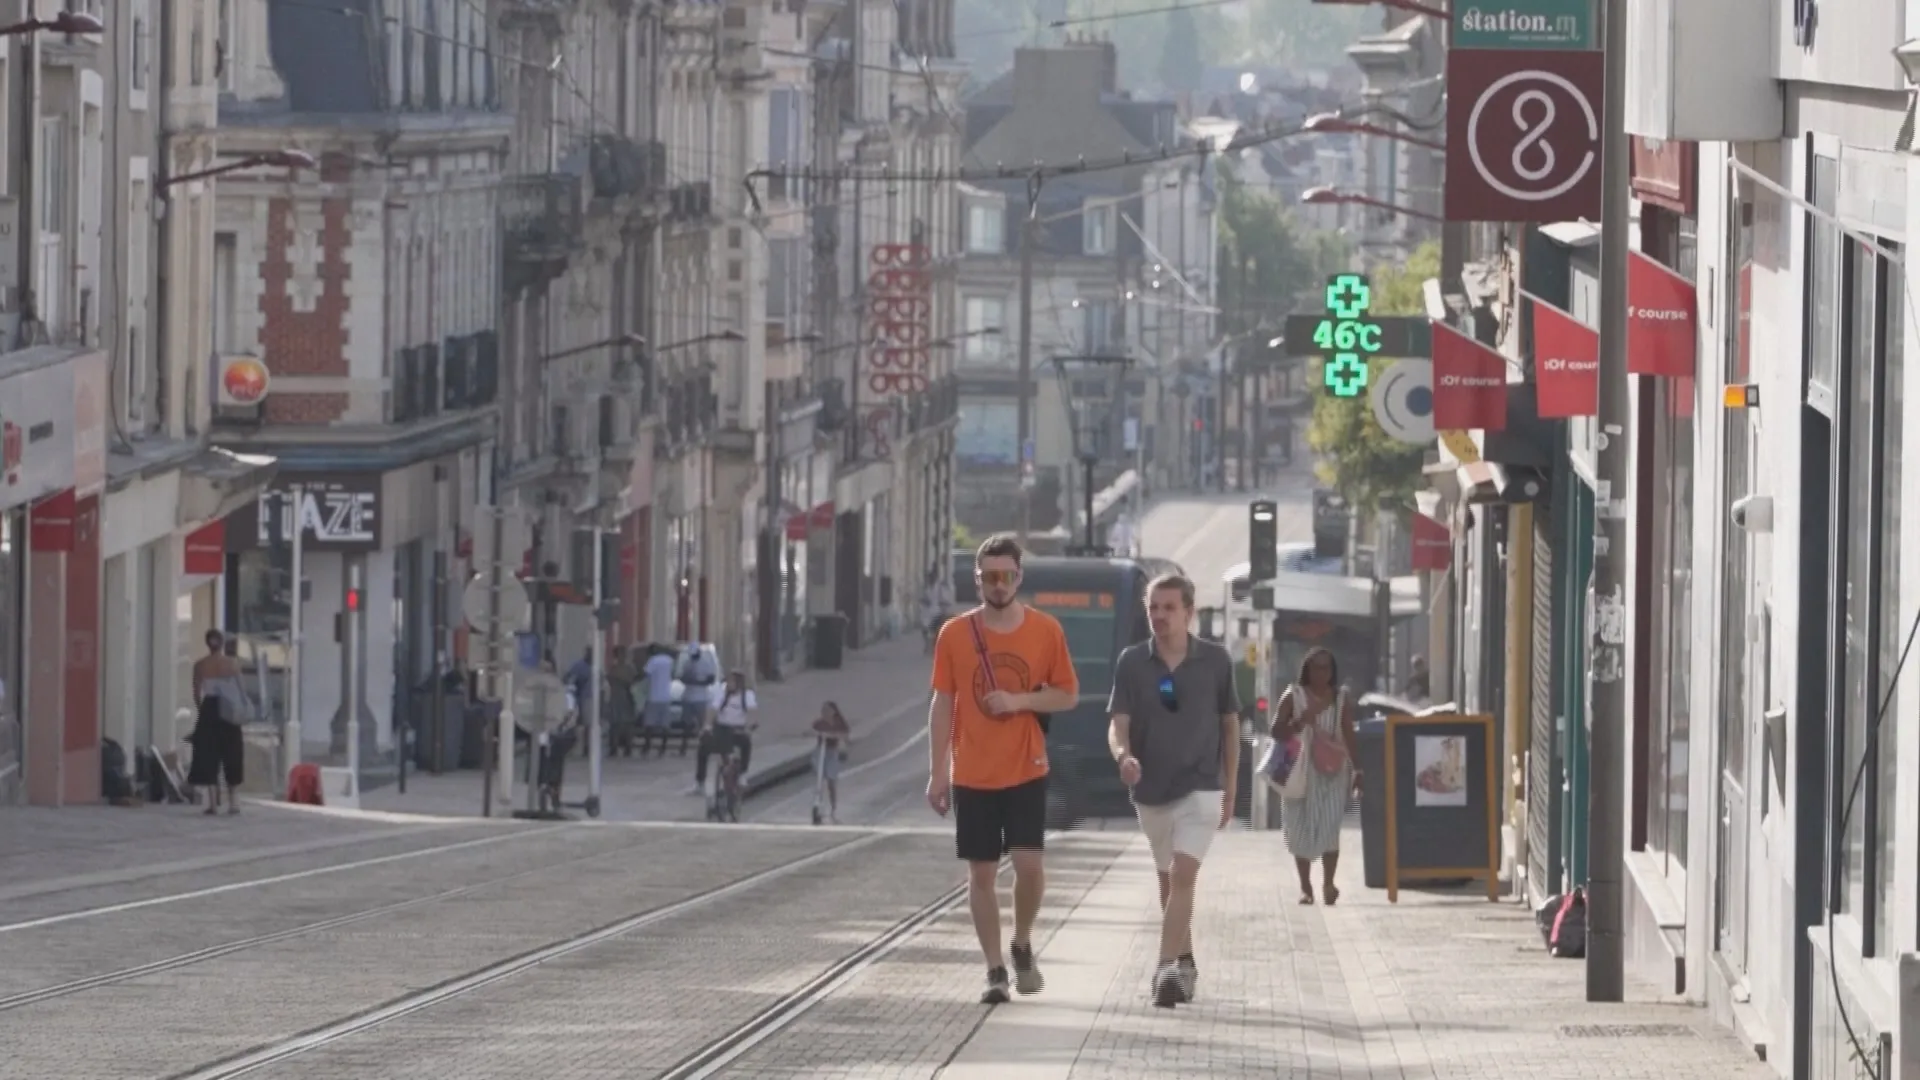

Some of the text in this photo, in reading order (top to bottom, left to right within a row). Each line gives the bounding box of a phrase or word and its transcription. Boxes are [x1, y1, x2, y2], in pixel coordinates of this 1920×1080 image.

[1638, 308, 1688, 320] course
[1313, 320, 1382, 351] 46°C
[1567, 361, 1598, 370] cour
